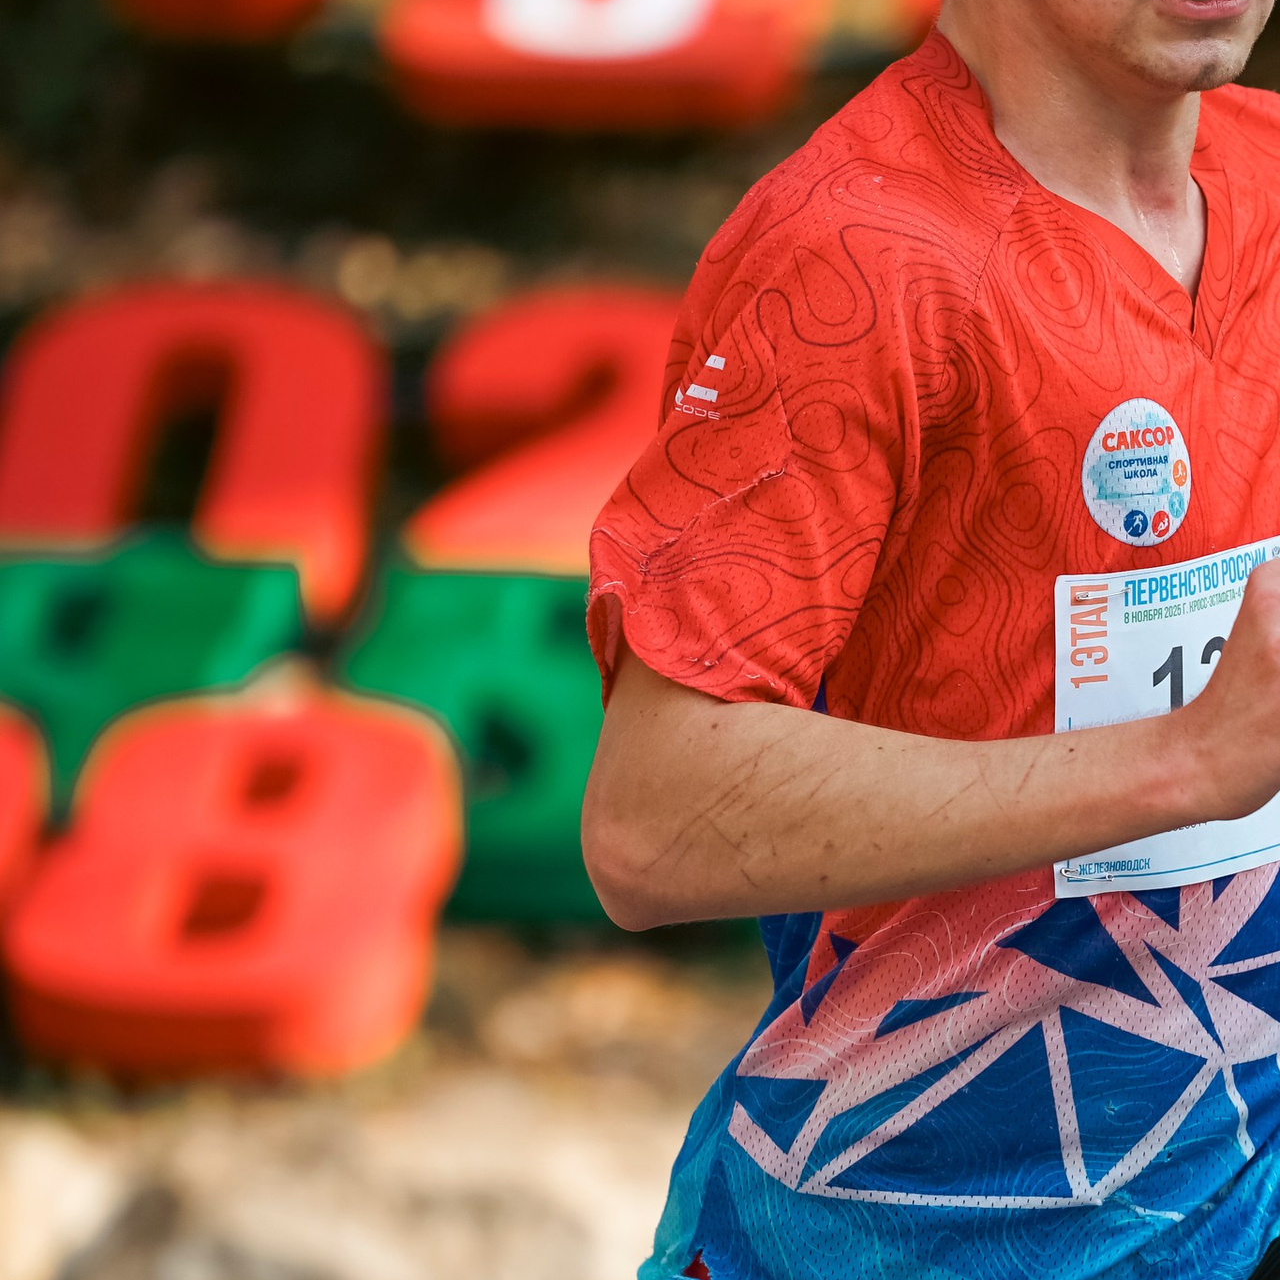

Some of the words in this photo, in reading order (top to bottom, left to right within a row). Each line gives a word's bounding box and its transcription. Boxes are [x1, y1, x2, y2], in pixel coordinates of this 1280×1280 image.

[1102, 425, 1175, 452] САКСОР
[1108, 455, 1169, 470] СПОРТИВНАЯ
[1124, 468, 1158, 480] ШКОЛА
[1124, 561, 1219, 607] ПЕРВЕНСТВО
[1124, 611, 1130, 624] 8
[1131, 607, 1163, 623] НОЯБРЯ
[1164, 603, 1182, 619] 2025
[1070, 583, 1109, 667] ЭТАП
[1078, 857, 1151, 876] ЖЕЛЕЗНОВОДСК
